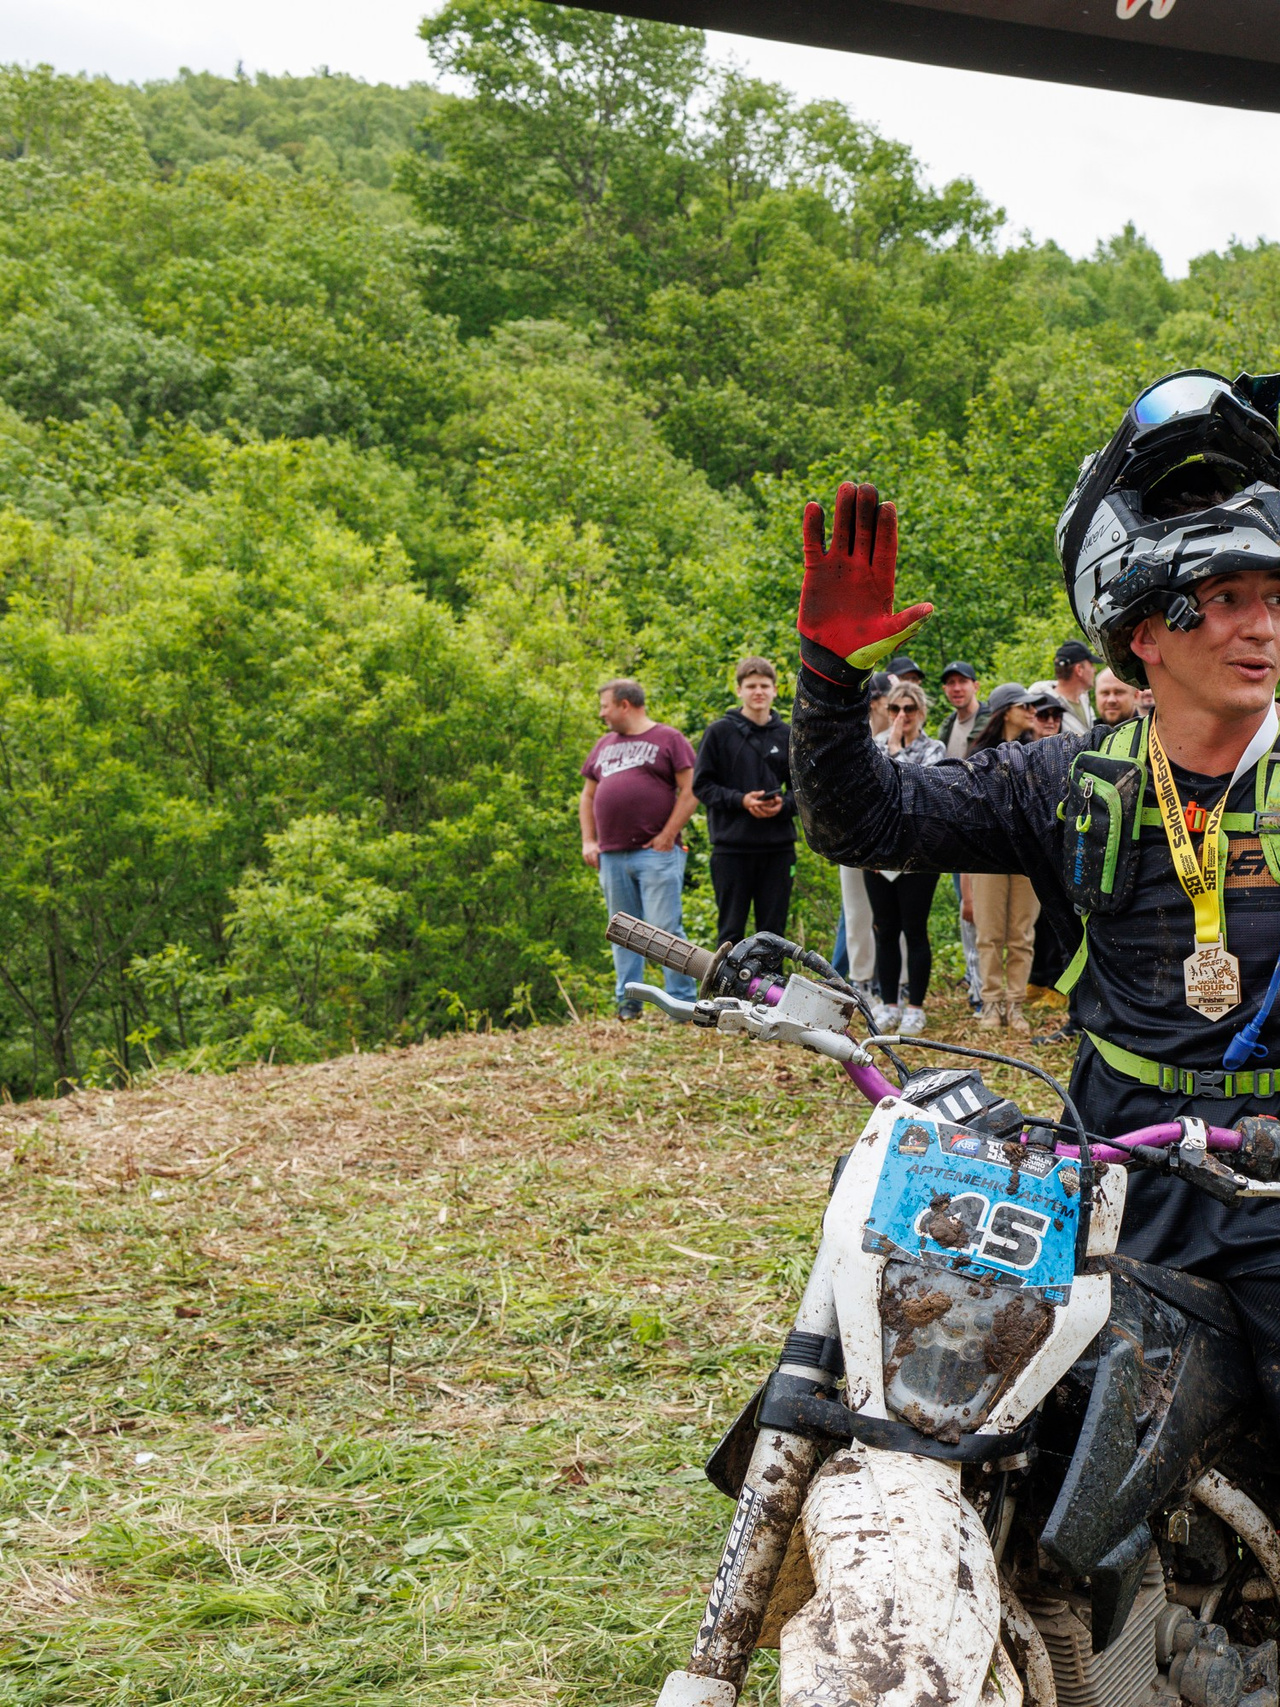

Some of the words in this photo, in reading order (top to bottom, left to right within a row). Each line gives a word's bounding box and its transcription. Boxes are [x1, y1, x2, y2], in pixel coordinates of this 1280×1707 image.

[1197, 947, 1221, 962] SET
[1200, 958, 1223, 968] PROJECT
[1188, 984, 1234, 992] ENDURO
[906, 1164, 1016, 1194] АРТЕМЕНК
[1044, 1288, 1064, 1302] 25
